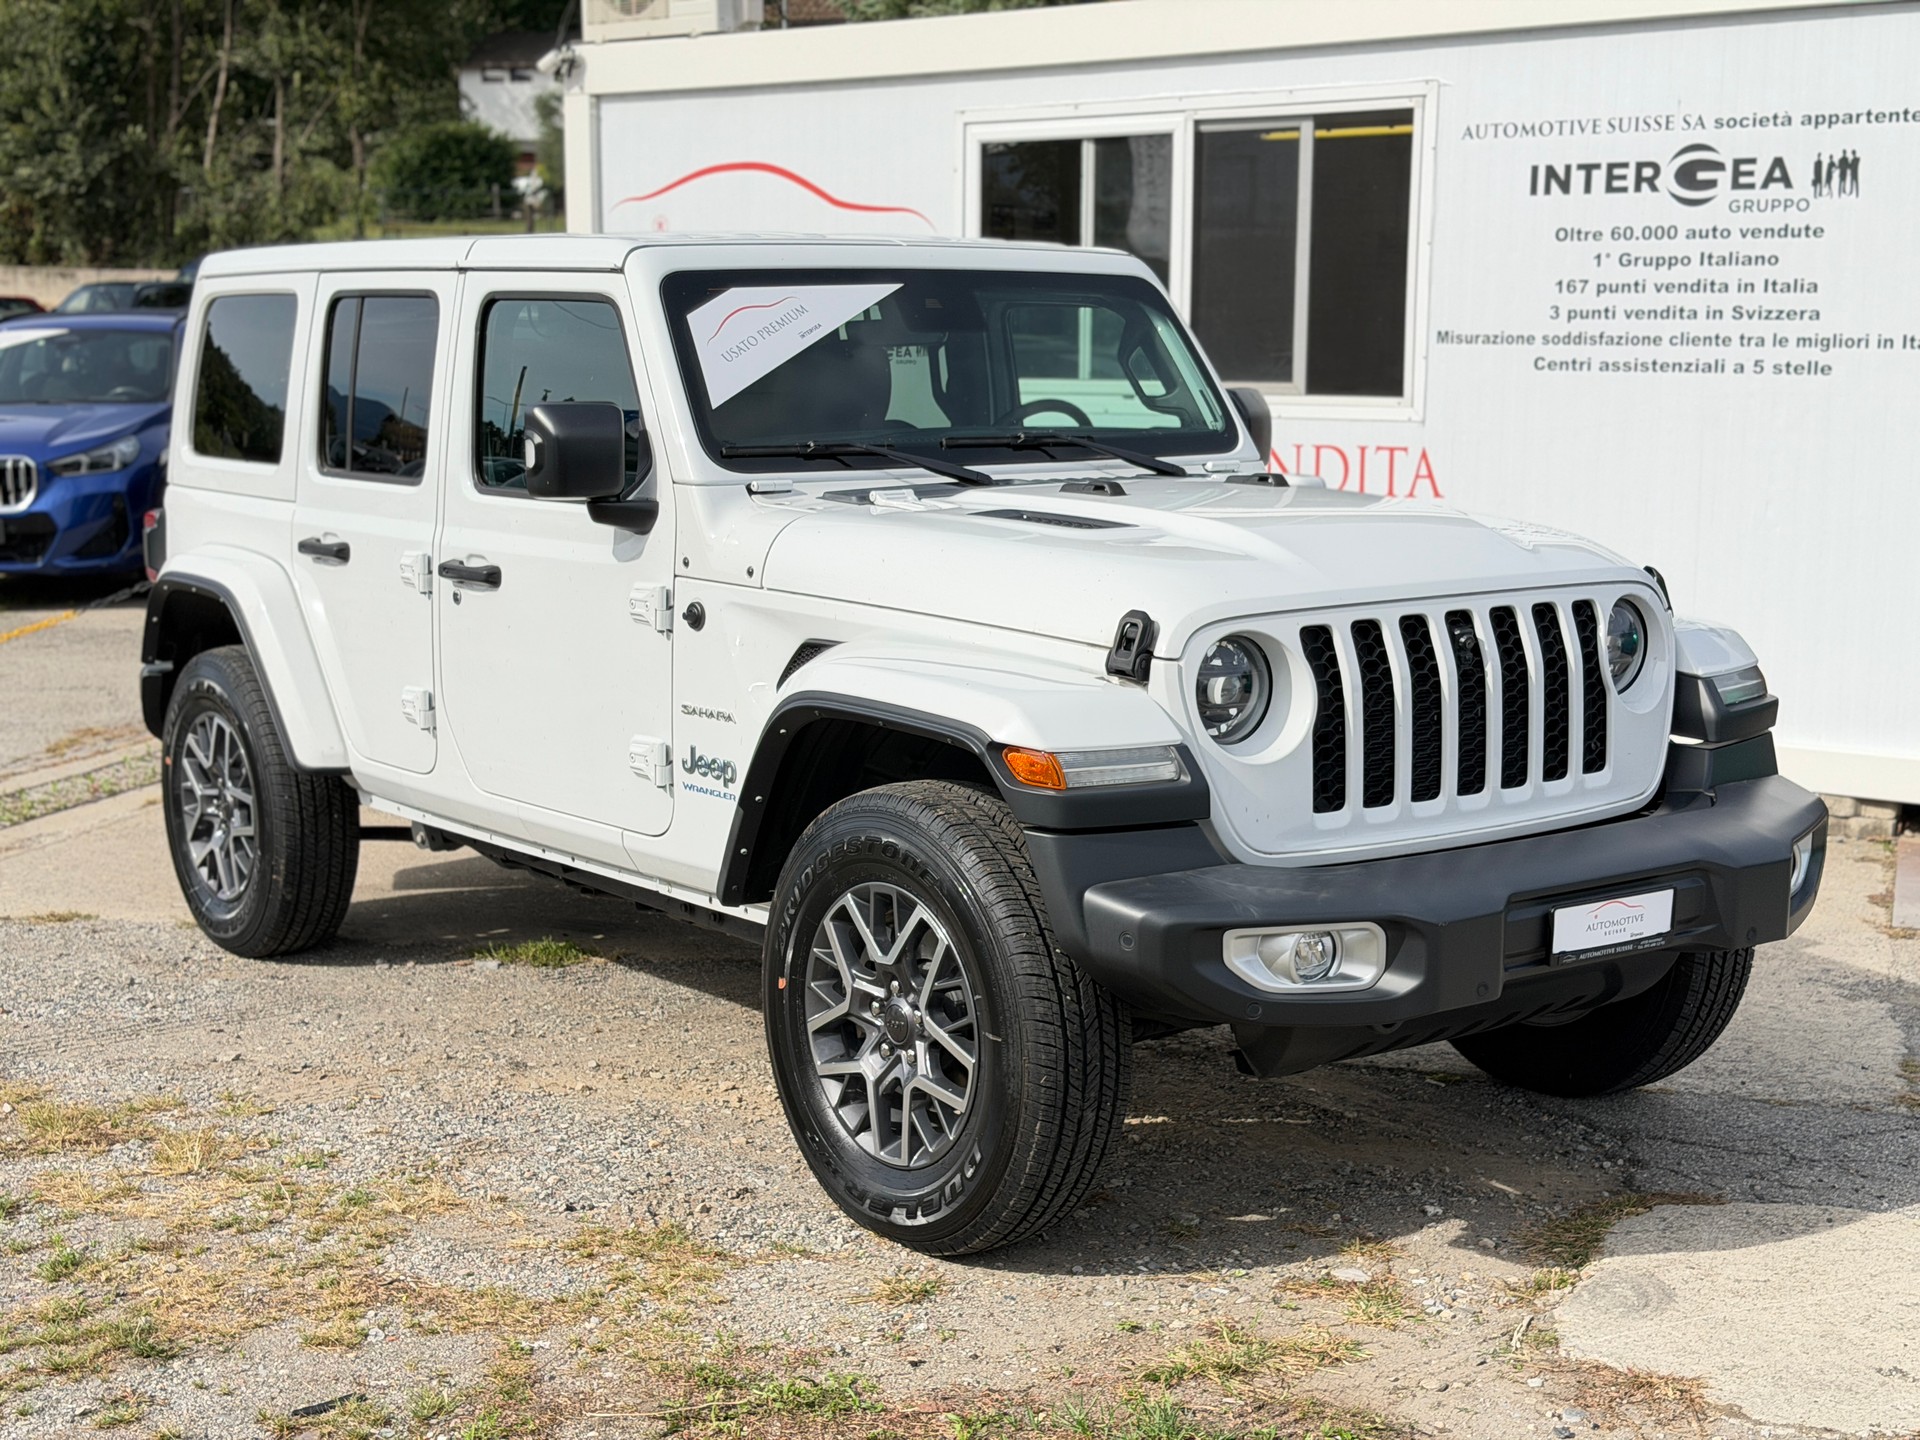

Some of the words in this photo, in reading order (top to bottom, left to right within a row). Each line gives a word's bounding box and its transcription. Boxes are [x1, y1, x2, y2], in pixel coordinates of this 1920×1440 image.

[1462, 119, 1600, 139] AUTOMOTIVE
[1607, 115, 1674, 133] SUISSE
[1682, 114, 1706, 130] SA
[1714, 111, 1792, 129] società
[1801, 108, 1920, 129] appartente
[1530, 145, 1794, 207] INTERGEA
[1729, 198, 1810, 213] GRUPPO
[1555, 227, 1603, 242] Oltre
[1611, 225, 1678, 241] 60.000
[1685, 225, 1731, 240] auto
[1739, 223, 1824, 239] vendute
[1618, 253, 1691, 271] Gruppo
[1700, 251, 1779, 266] Italiano
[1555, 279, 1589, 294] 167
[1596, 279, 1646, 297] punti
[1654, 278, 1729, 293] vendita
[1737, 278, 1755, 293] in
[1764, 278, 1818, 293] Italia
[1550, 305, 1560, 320] 3
[1567, 305, 1616, 323] punti
[1624, 305, 1697, 320] vendita
[1706, 305, 1723, 320] in
[1732, 305, 1820, 321] Svizzera
[721, 335, 758, 362] USATO
[757, 304, 809, 340] PREMIUM
[1437, 330, 1535, 345] Misurazione
[1542, 331, 1662, 346] soddisfazione
[1669, 332, 1732, 347] cliente
[1739, 333, 1765, 347] tra
[1773, 333, 1789, 348] le
[1796, 333, 1869, 352] migliori
[1877, 334, 1894, 349] in
[1902, 334, 1920, 350] It
[1534, 357, 1591, 371] Centri
[1599, 358, 1725, 373] assistenziali
[1733, 363, 1744, 374] a
[1753, 360, 1764, 374] 5
[1773, 360, 1832, 376] stelle
[681, 704, 737, 725] SAHARA
[682, 744, 737, 789] Jeep
[682, 781, 737, 802] WRANGLER
[774, 835, 940, 957] BRIDGESTONE
[1586, 913, 1644, 932] AUTOMOTIVE
[844, 1138, 982, 1220] DUELER
